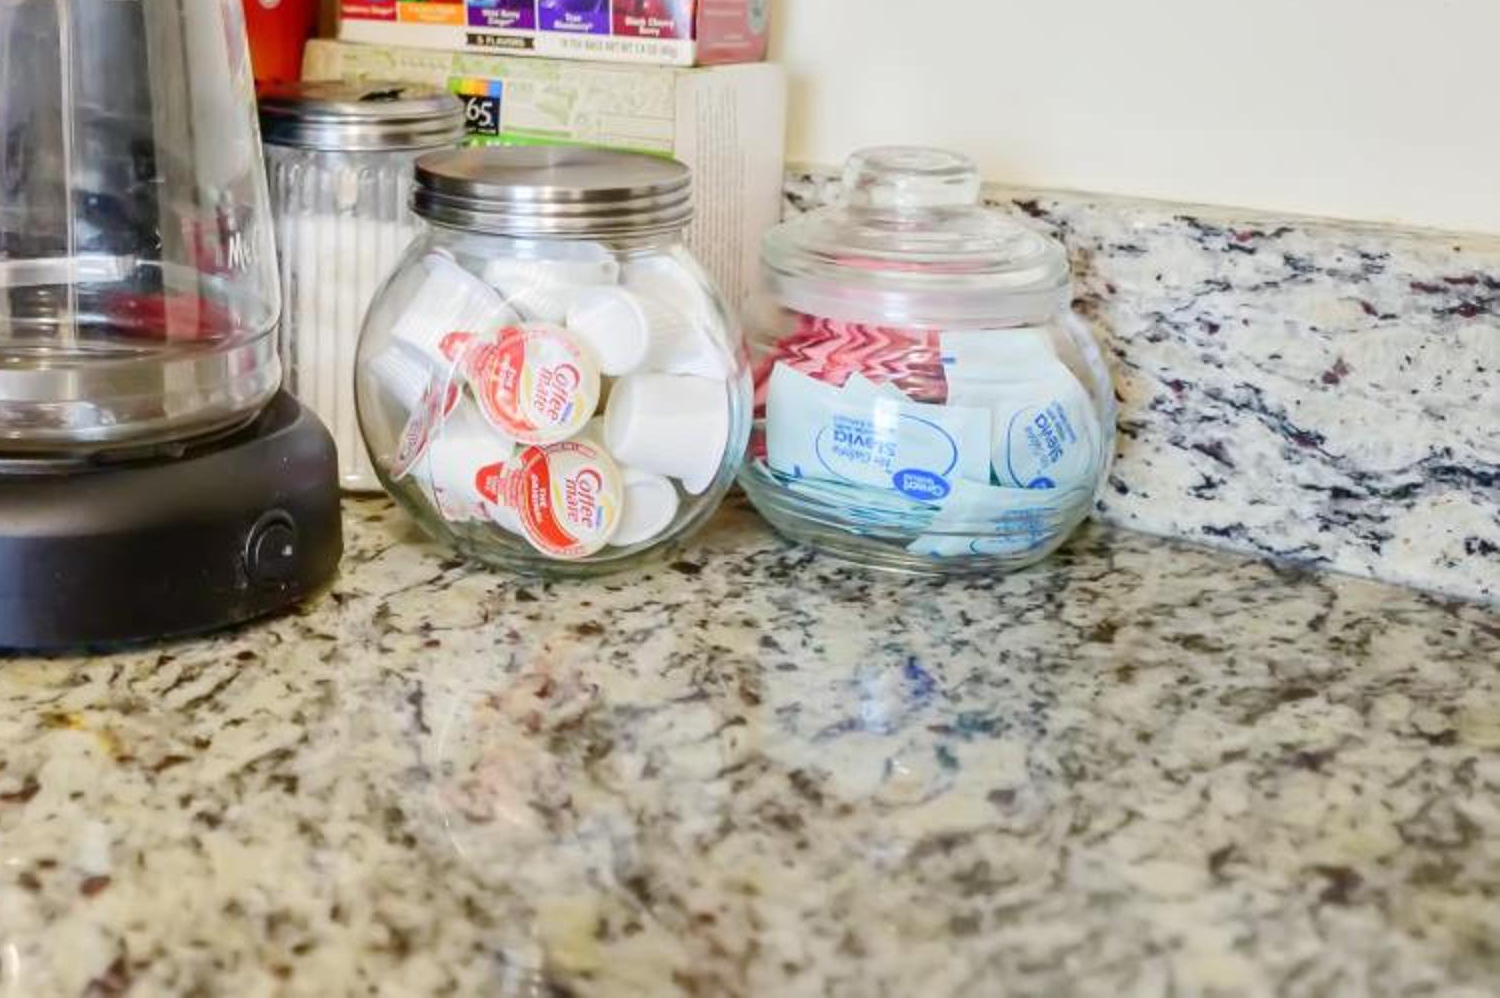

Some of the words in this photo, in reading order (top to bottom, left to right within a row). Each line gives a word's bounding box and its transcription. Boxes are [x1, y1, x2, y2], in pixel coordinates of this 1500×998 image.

[534, 367, 553, 412] mate
[547, 363, 581, 422] Coffee
[565, 478, 579, 523] mate
[575, 468, 603, 528] Coffee
